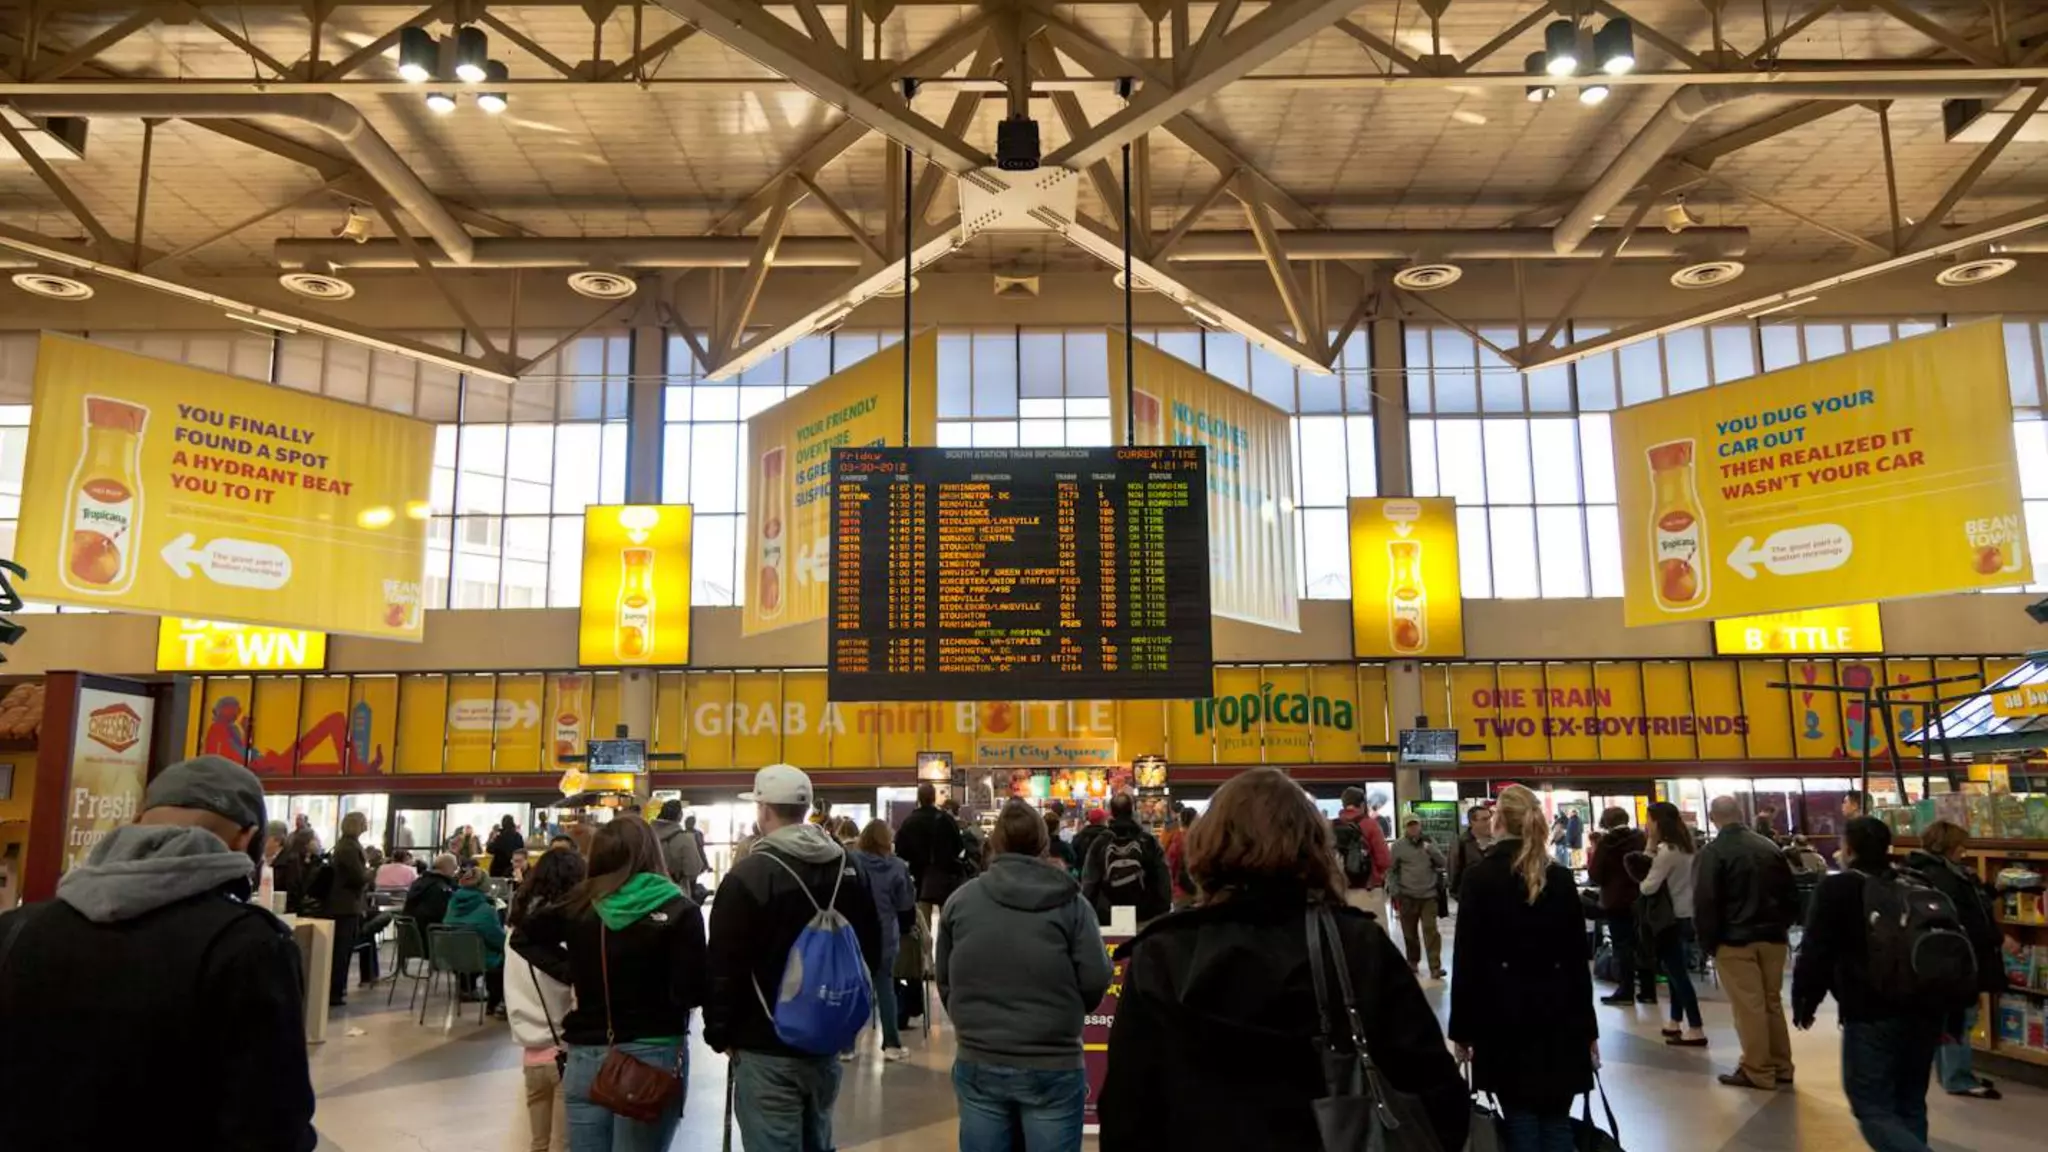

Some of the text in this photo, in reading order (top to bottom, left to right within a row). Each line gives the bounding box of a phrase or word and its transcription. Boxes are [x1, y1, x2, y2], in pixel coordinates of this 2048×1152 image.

[177, 404, 315, 445] YOU FINALLY
[826, 394, 878, 430] FRIENDLY
[1172, 399, 1195, 425] NO
[1717, 389, 1874, 436] YOU DUG YOUR
[174, 427, 328, 469] FOUND A SPOT
[945, 450, 1090, 459] SOUTH STATION TRAIN INFORMATION
[1117, 450, 1198, 459] CURRENT TIME
[1718, 427, 1806, 457] CAR OUT
[1720, 428, 1914, 478] THEN REALIZED IT
[172, 451, 353, 496] A HYDRANT BEAT
[839, 462, 907, 472] 03-30-2012
[1184, 461, 1198, 470] PM
[1722, 451, 1924, 500] WASN'T YOUR CAR
[170, 473, 275, 504] YOU TO IT
[795, 483, 831, 507] SUSPIC
[83, 507, 127, 524] Tropicana
[1965, 514, 2018, 533] BEAN
[1194, 682, 1353, 735] Tropicana
[1472, 688, 1612, 709] ONE TRAIN
[694, 701, 808, 736] GRAB
[818, 701, 846, 736] A
[857, 700, 944, 734] mini
[1474, 715, 1751, 737] TWO EX-BOYFRIENDS
[980, 744, 1015, 760] Surf
[1019, 744, 1050, 760] City
[72, 787, 136, 819] Fresh
